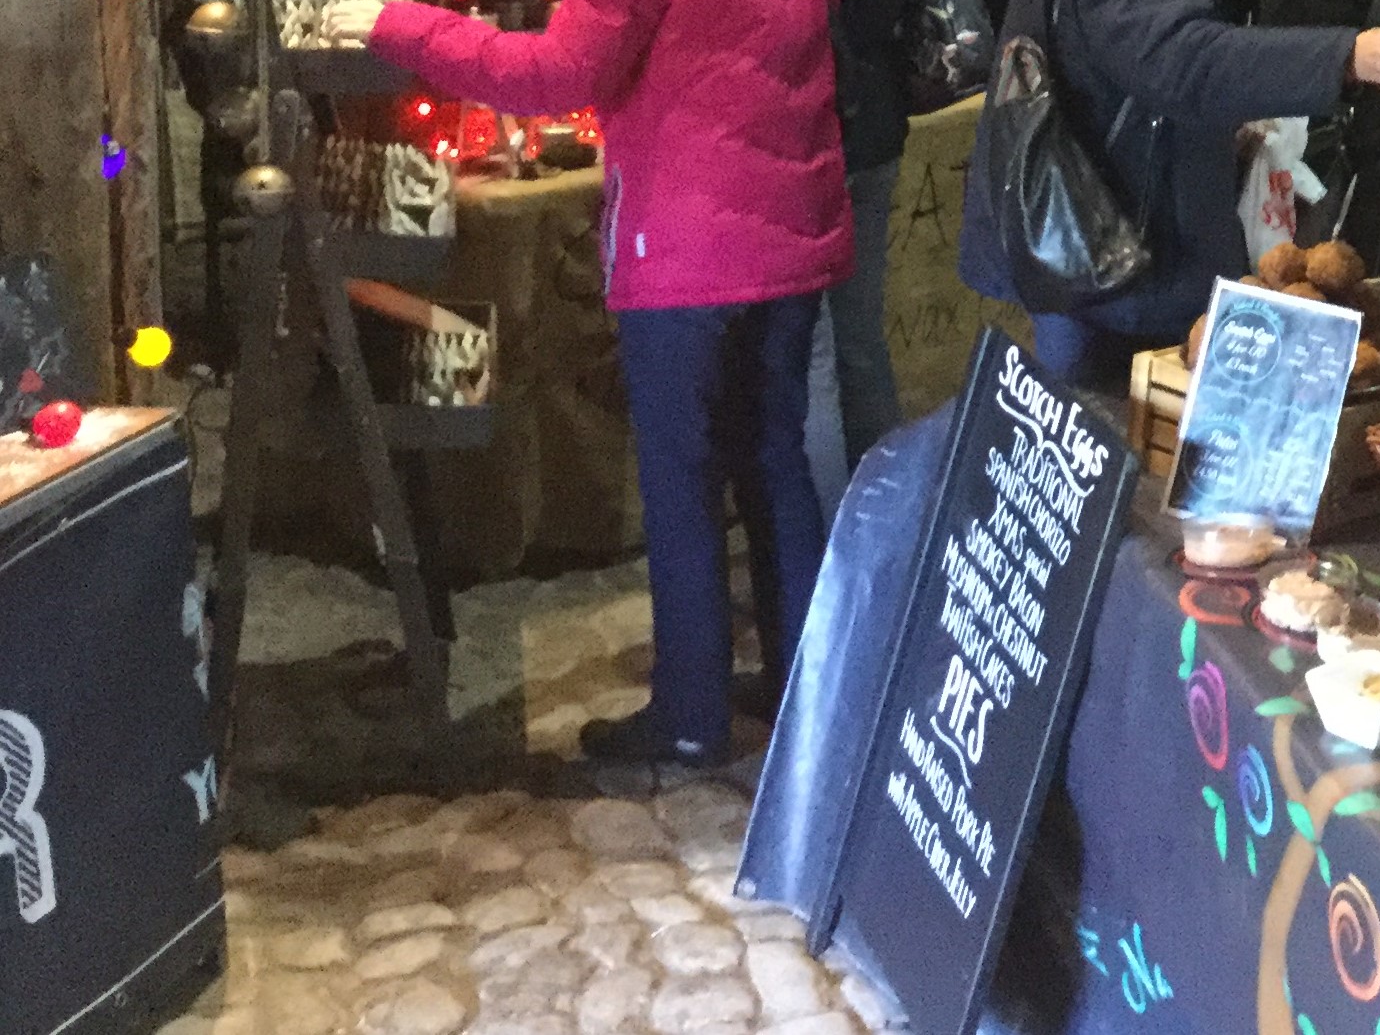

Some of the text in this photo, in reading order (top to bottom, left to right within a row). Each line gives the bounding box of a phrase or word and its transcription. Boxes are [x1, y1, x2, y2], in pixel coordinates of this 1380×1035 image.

[999, 345, 1063, 435] SCOTCH
[984, 446, 1033, 513] SPANISH
[987, 492, 1026, 560] XMAS
[941, 534, 993, 620] MUSHROOM
[992, 603, 1048, 685] CHESTNUT
[965, 518, 1044, 636] SMOKEY BACON
[937, 654, 993, 764] PIES
[957, 607, 984, 666] FISH
[979, 638, 1014, 709] CAKES
[900, 783, 930, 850] APPLE
[924, 822, 950, 884] CIDER
[944, 857, 976, 918] JELLY
[950, 784, 980, 851] PORK
[975, 820, 995, 876] PIE
